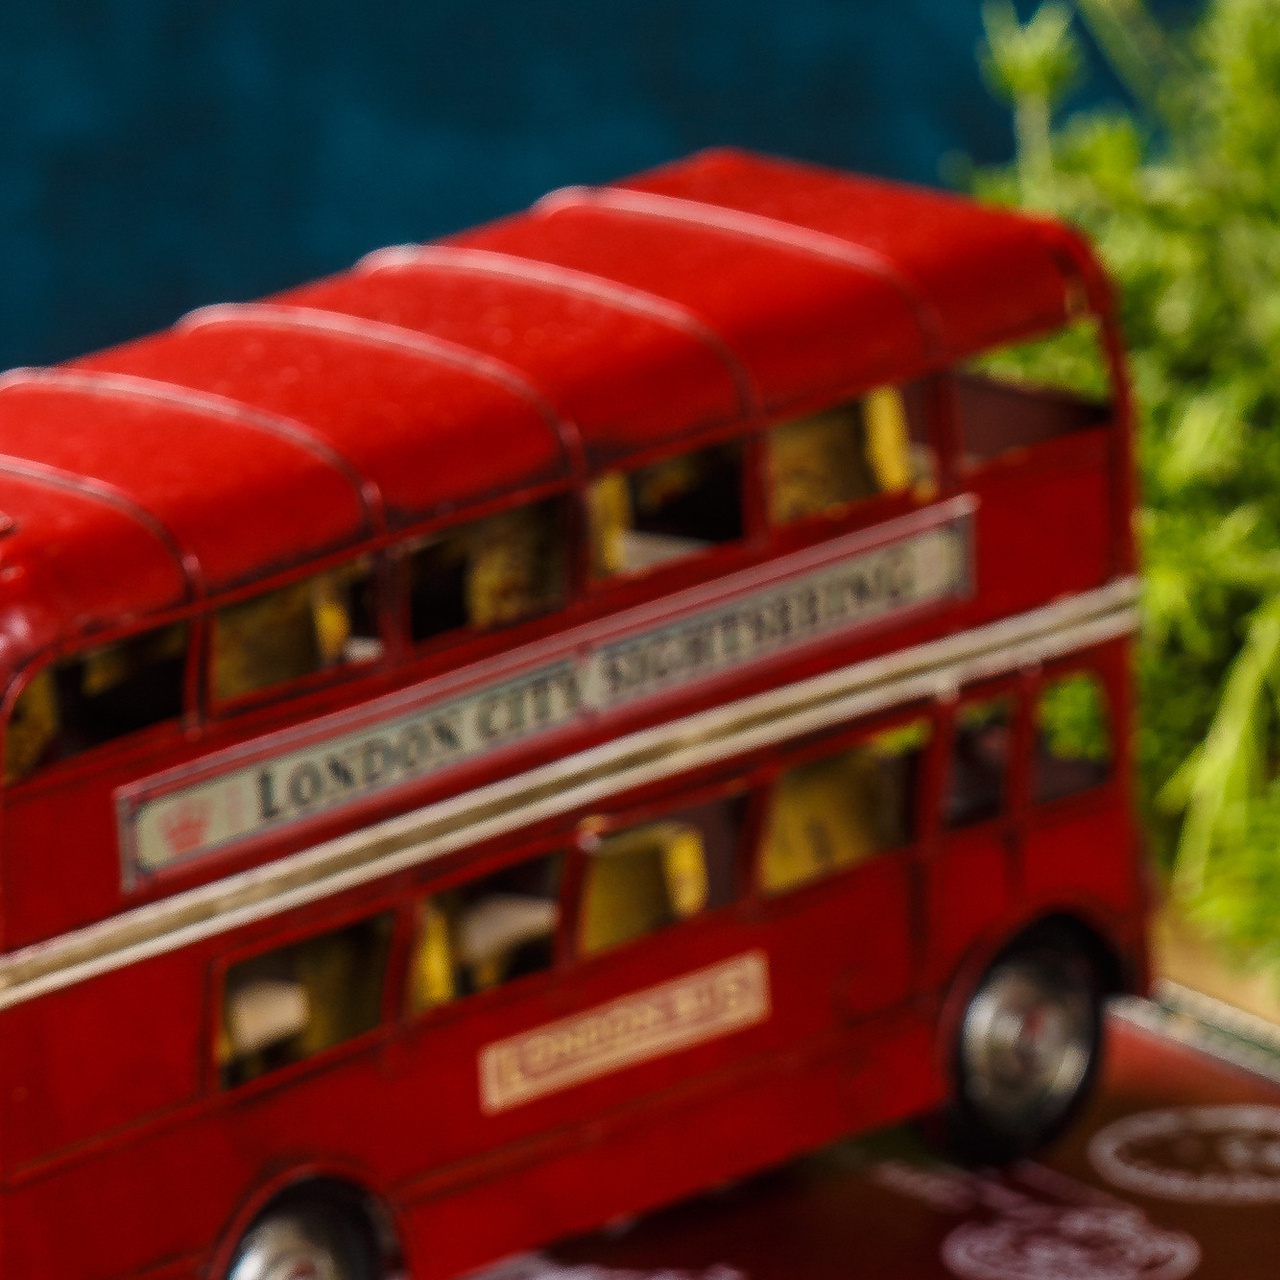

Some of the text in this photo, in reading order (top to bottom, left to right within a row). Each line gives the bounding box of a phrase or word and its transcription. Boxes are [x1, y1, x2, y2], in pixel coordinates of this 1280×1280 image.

[256, 545, 918, 820] LONDON CITY SIGHTSEEING
